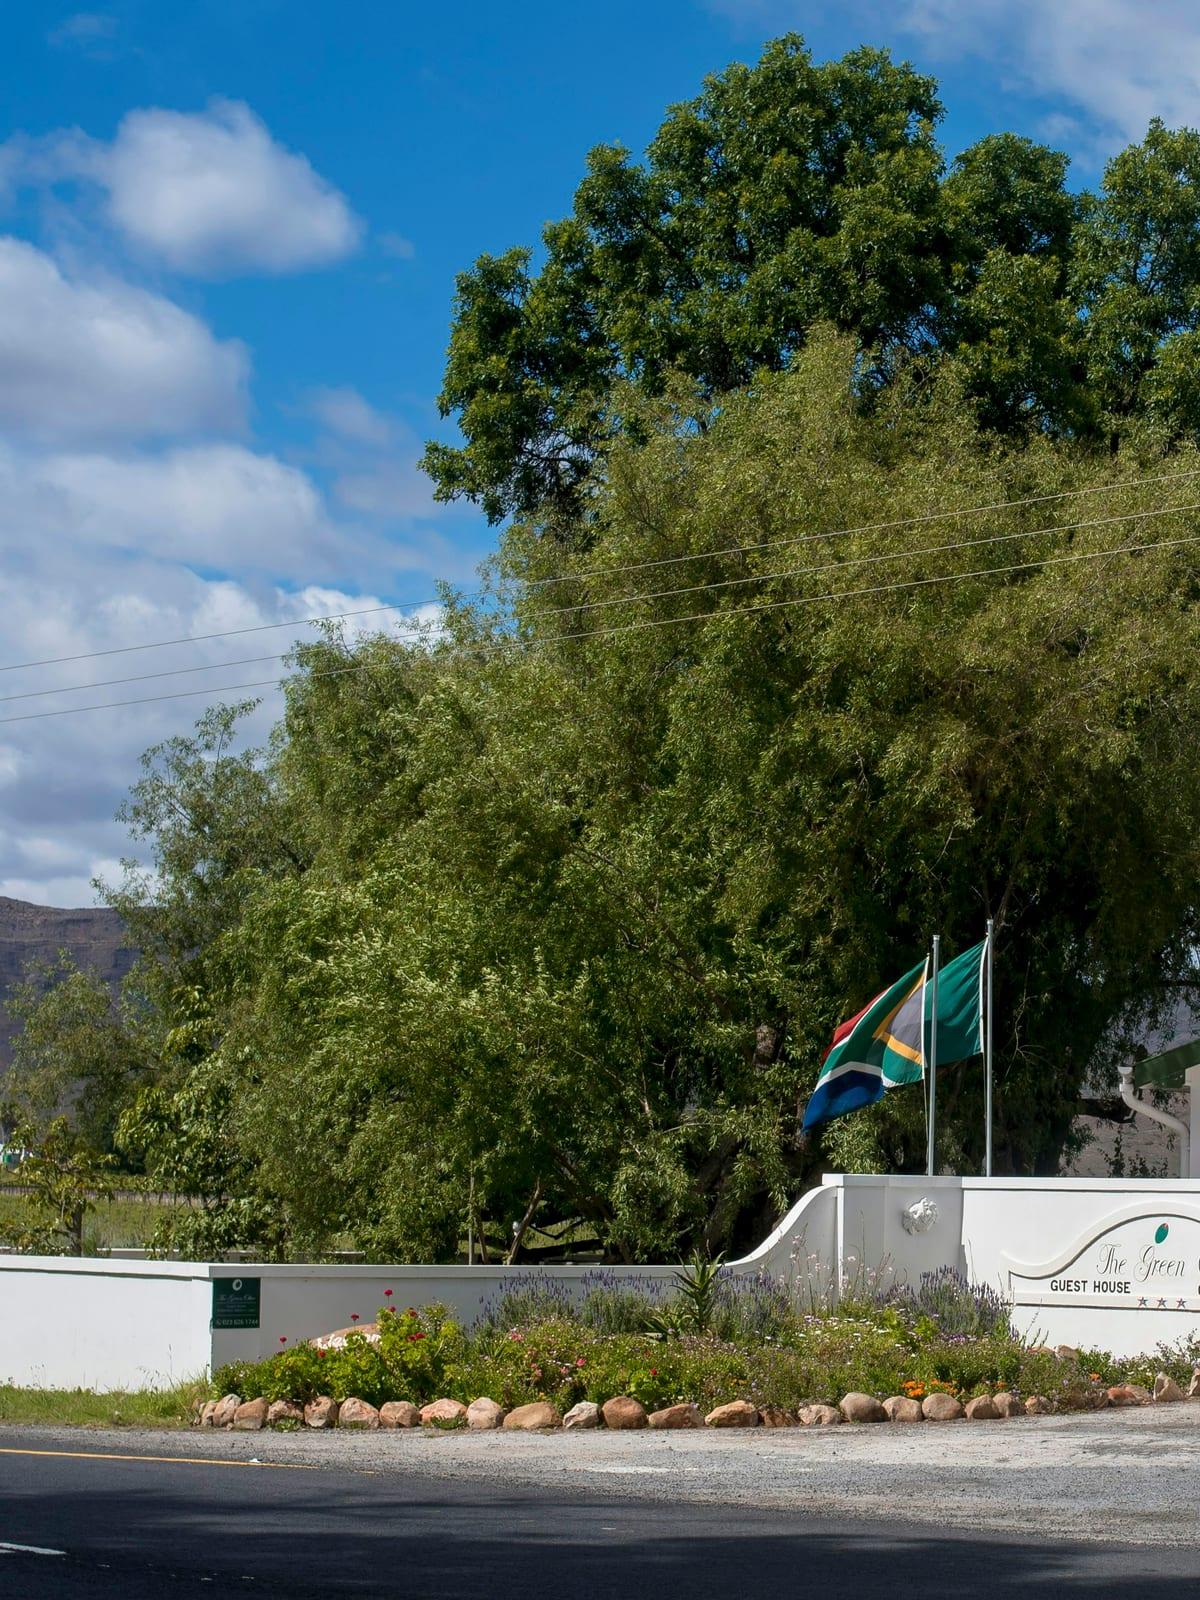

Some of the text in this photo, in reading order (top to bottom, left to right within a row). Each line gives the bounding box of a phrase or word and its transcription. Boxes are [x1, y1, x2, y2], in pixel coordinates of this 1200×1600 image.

[1096, 1244, 1127, 1274] The
[1134, 1244, 1185, 1282] Green
[1050, 1280, 1131, 1293] GUEST HOUSE
